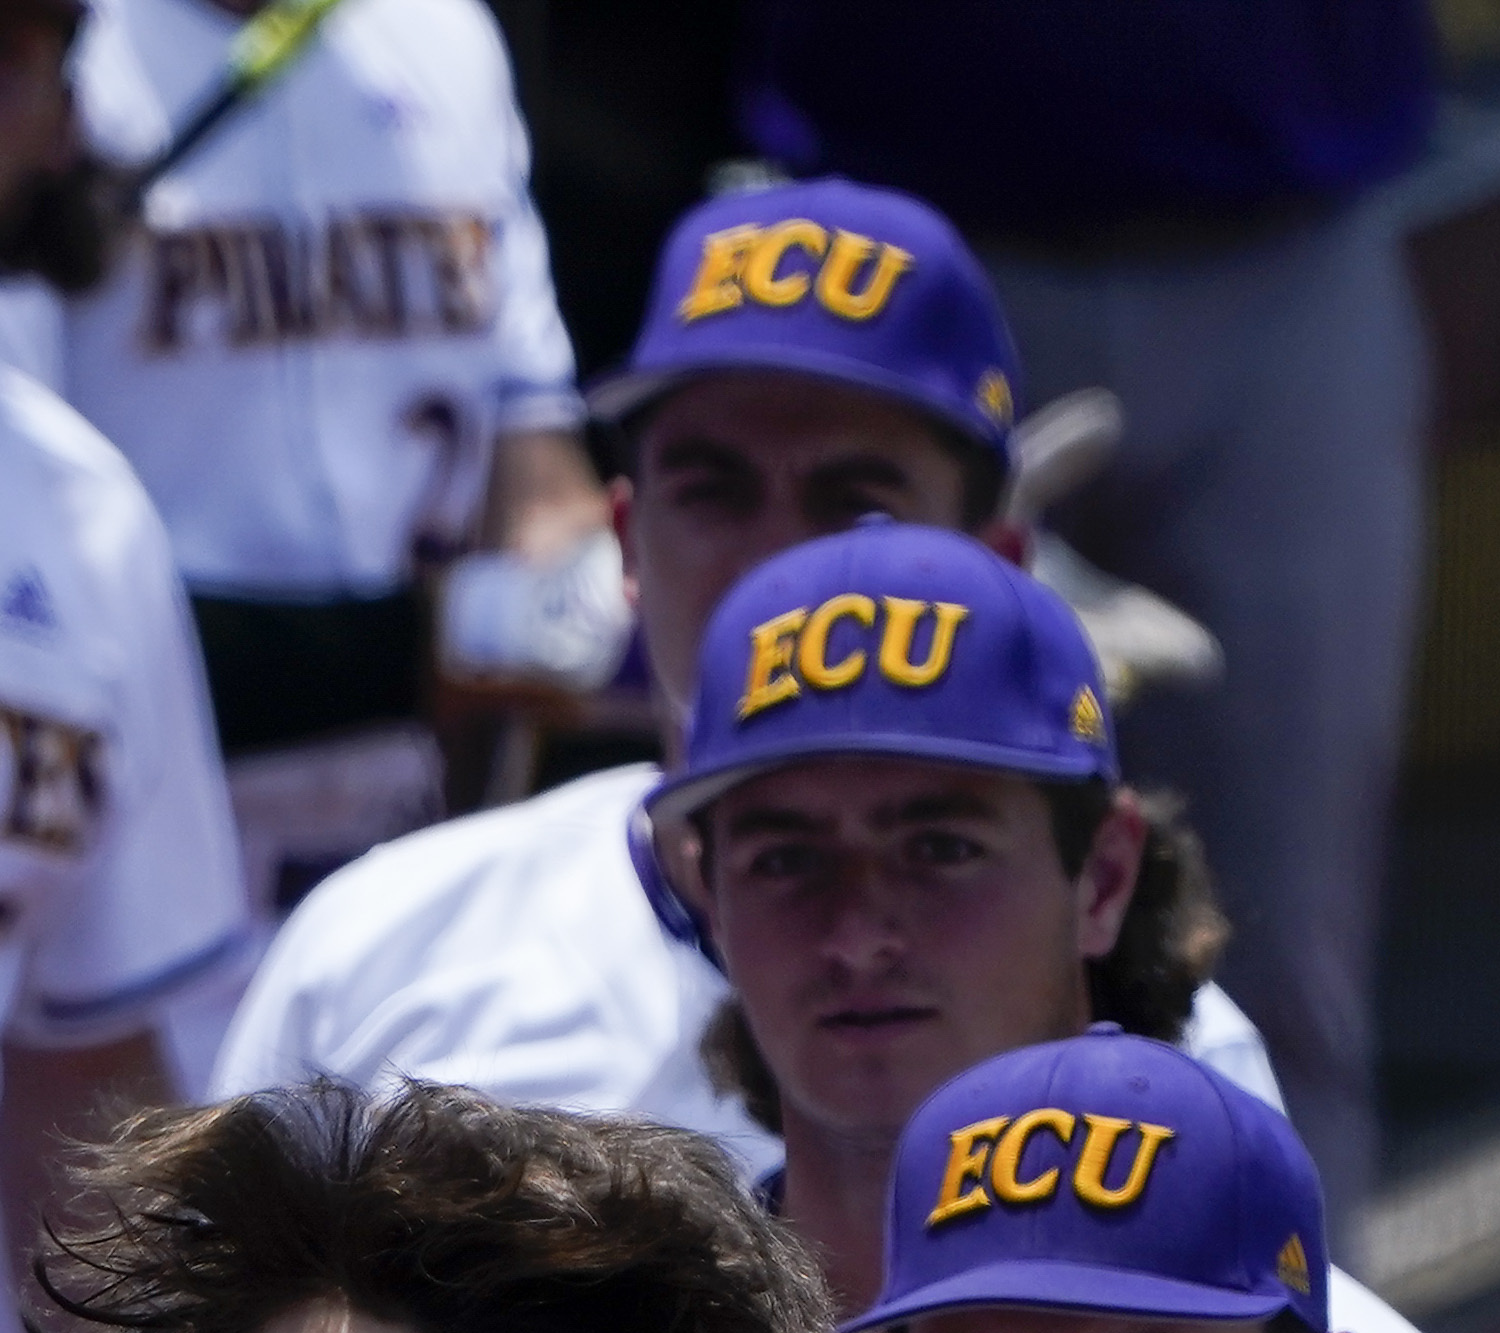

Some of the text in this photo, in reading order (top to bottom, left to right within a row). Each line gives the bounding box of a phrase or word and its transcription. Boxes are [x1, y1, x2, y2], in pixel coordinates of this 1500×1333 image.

[680, 218, 912, 322] ECU
[737, 592, 970, 722] ECU
[926, 1105, 1178, 1228] ECU
